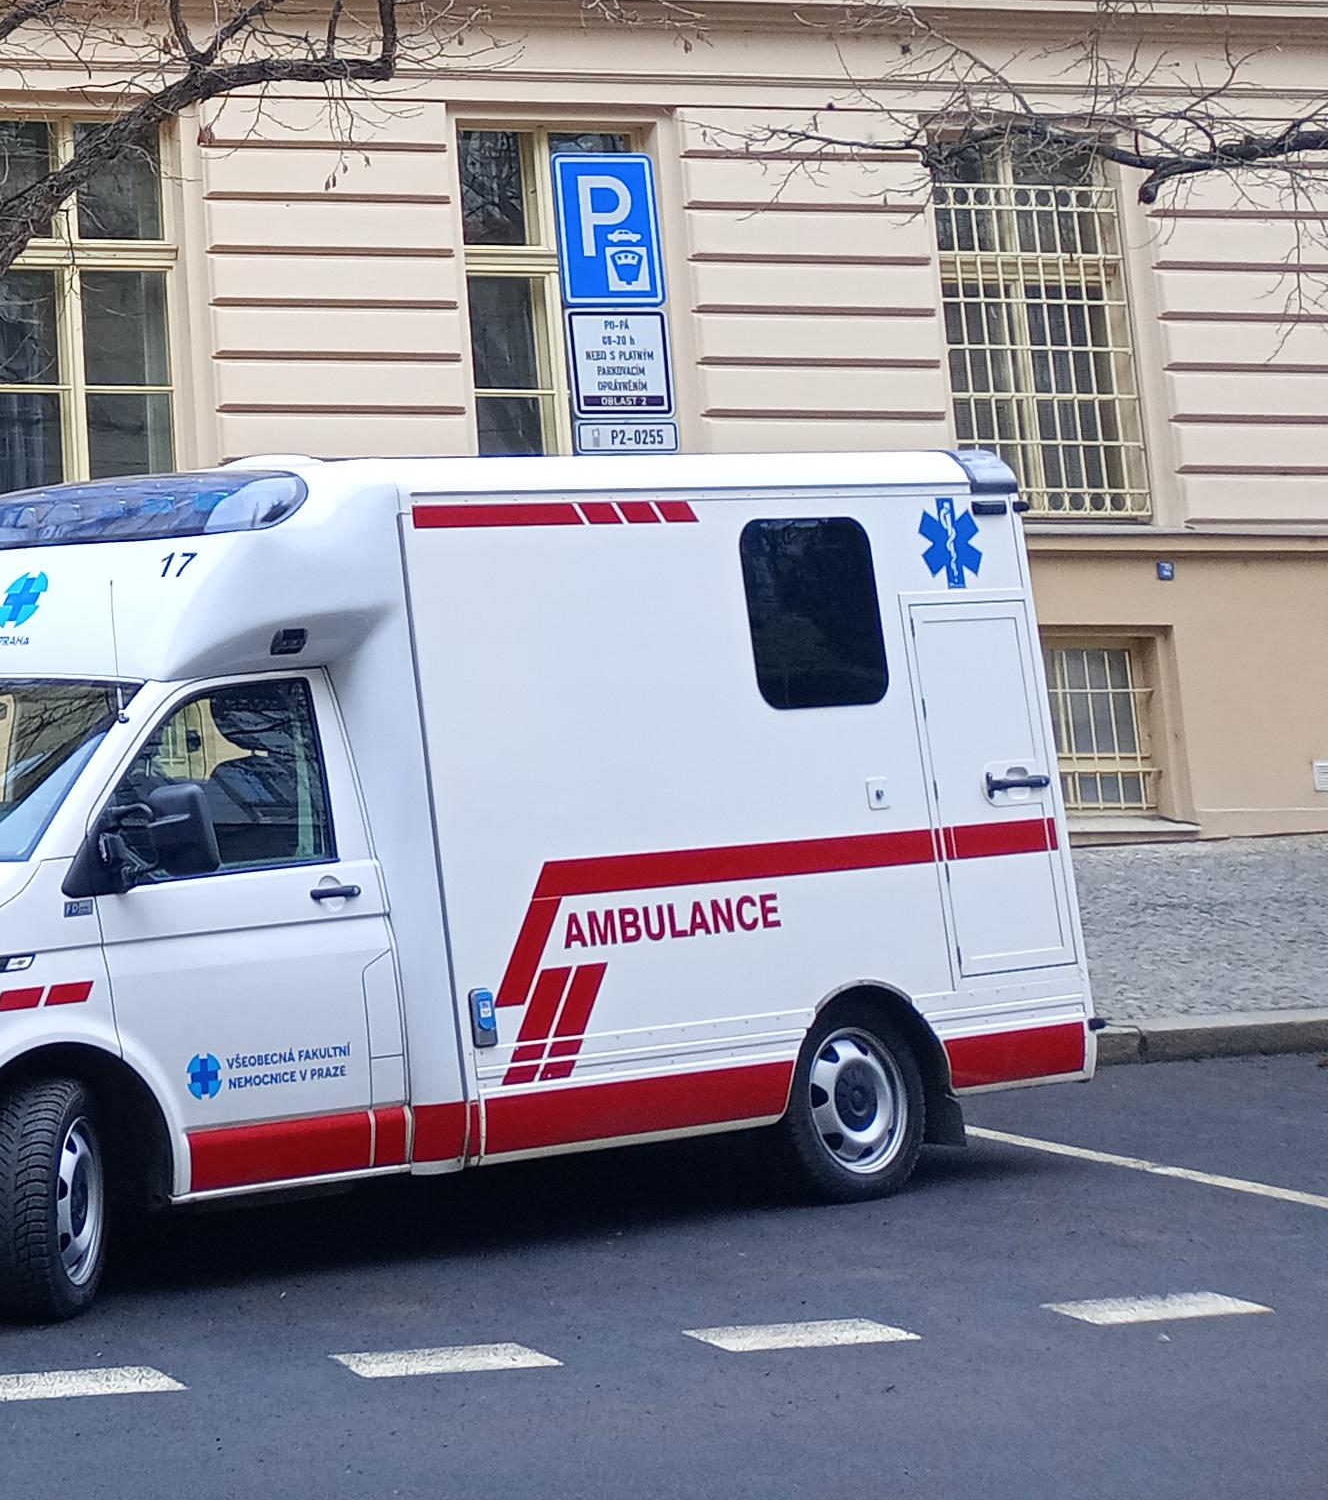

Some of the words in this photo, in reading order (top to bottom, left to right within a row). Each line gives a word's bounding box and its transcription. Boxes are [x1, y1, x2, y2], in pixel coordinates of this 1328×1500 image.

[577, 175, 632, 257] P
[604, 318, 630, 330] PO-PÁ
[586, 350, 607, 361] NEBO
[610, 350, 616, 361] S
[619, 348, 655, 361] PLATNÝM
[597, 364, 646, 376] PARKOVACÍM
[601, 397, 638, 406] OBLAST
[641, 396, 648, 406] 2
[610, 429, 664, 445] P2-0255
[160, 551, 198, 578] 17
[564, 892, 782, 949] AMBULANCE
[226, 1047, 296, 1070] VŠEOBECNÁ
[297, 1040, 351, 1062] FAKULTNÍ
[228, 1070, 297, 1090] NEMOCNICE
[299, 1069, 308, 1081] V
[310, 1064, 347, 1080] PRAZE
